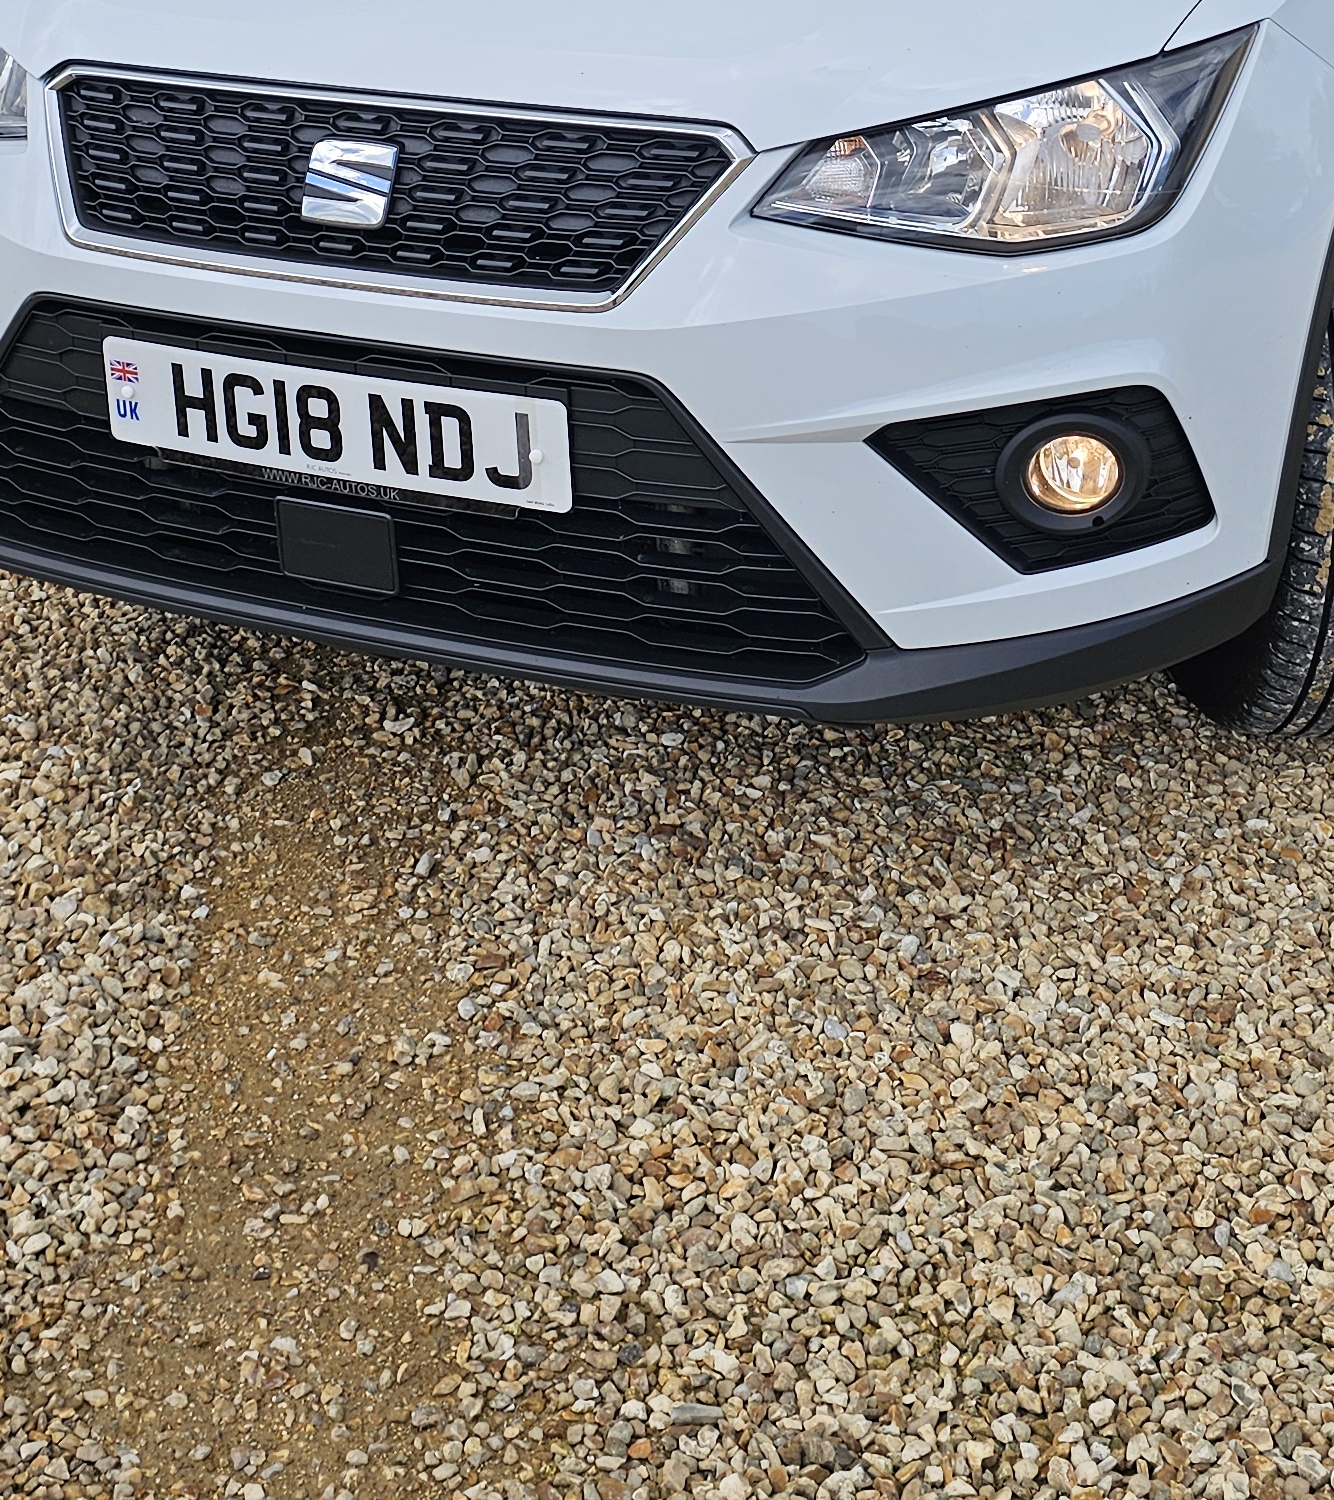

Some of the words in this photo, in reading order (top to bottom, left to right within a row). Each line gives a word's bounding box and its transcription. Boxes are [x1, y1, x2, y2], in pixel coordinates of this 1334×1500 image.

[115, 398, 140, 421] UK
[170, 362, 344, 463] HG18
[367, 392, 533, 490] NDJ
[261, 467, 400, 501] WWW.RJC-AUTOS.UK
